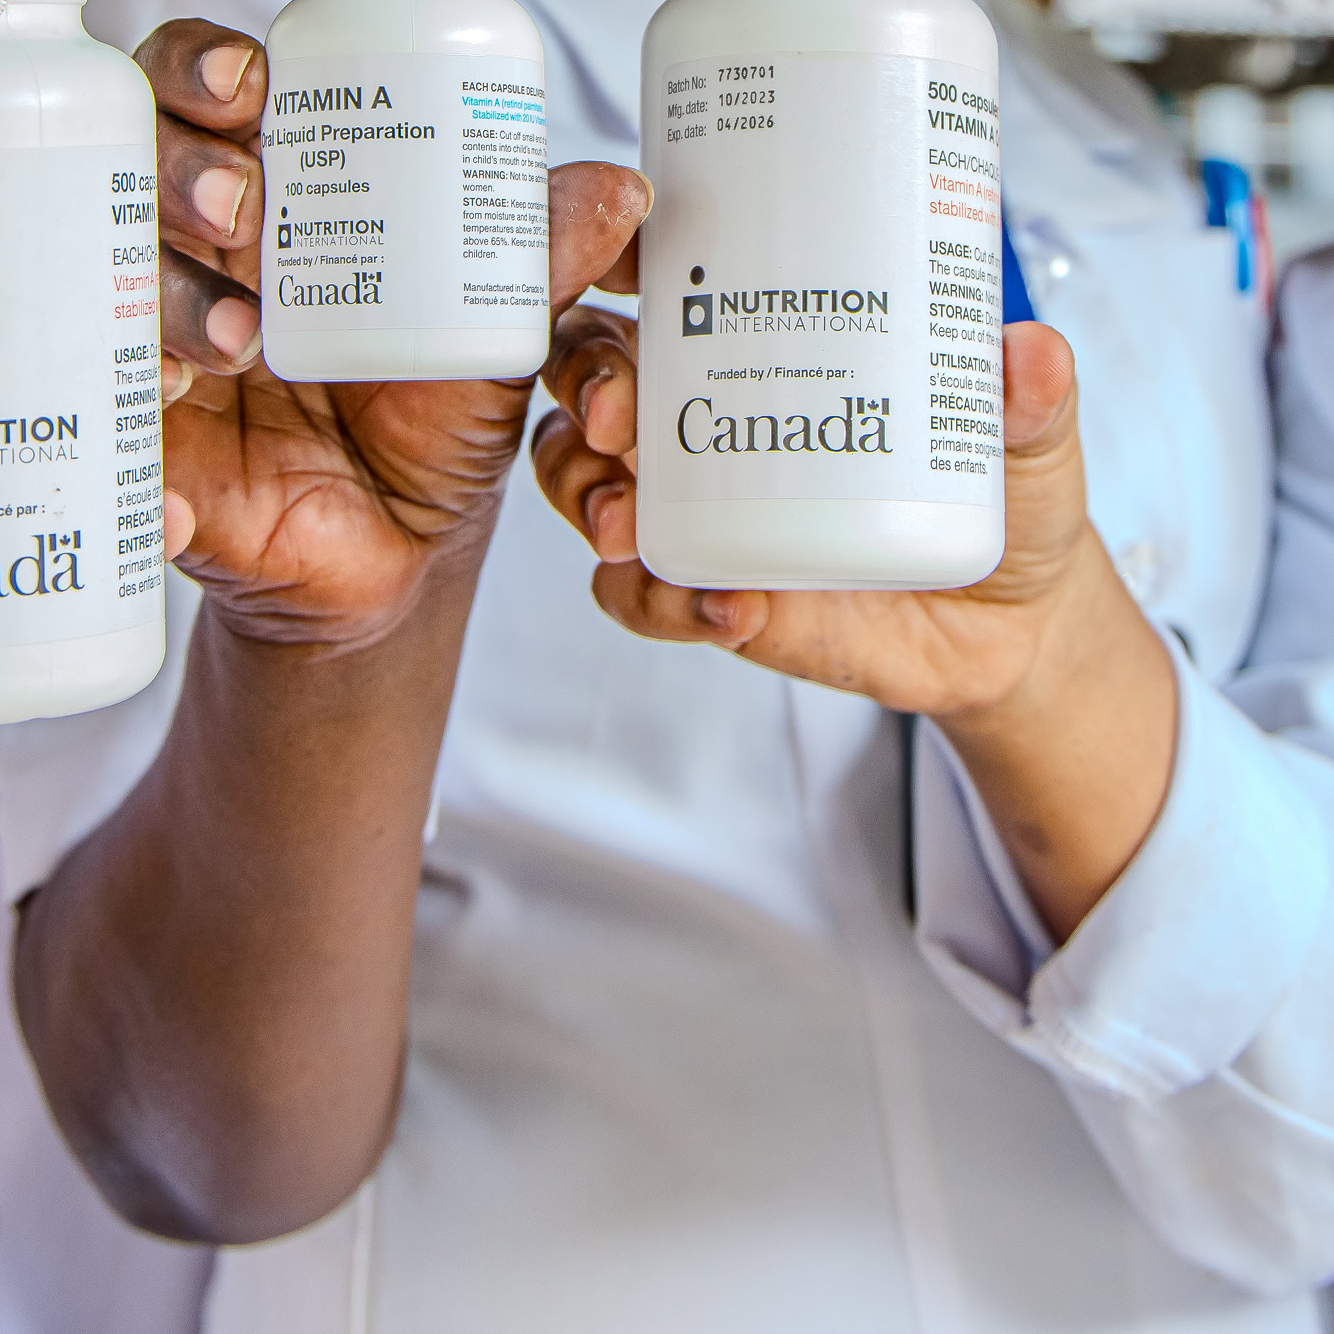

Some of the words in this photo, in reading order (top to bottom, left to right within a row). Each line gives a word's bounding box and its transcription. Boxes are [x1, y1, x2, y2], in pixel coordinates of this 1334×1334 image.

[462, 82, 488, 91] EACH
[491, 83, 524, 95] CAPSULE
[668, 78, 689, 94] Batch
[692, 76, 707, 90] No:
[718, 65, 774, 82] 7730701
[274, 86, 362, 116] VITAMIN
[371, 86, 392, 109] A
[928, 81, 957, 102] 500
[462, 97, 492, 106] Vitamin
[495, 98, 500, 107] A
[668, 104, 684, 118] Mfg.
[686, 100, 707, 114] date:
[719, 90, 775, 106] 10/2023
[472, 110, 509, 120] Stabilized
[262, 130, 274, 148] Oral
[276, 125, 315, 147] Liquid
[321, 122, 435, 144] Preparation
[462, 129, 497, 138] USAGE:
[500, 130, 511, 140] Cut
[668, 128, 683, 143] Exp.
[685, 124, 707, 139] date:
[717, 115, 774, 131] 04/2026
[928, 110, 987, 140] VITAMIN
[990, 126, 995, 144] A
[462, 143, 497, 151] contents
[499, 143, 511, 152] into
[513, 144, 530, 154] child's
[301, 149, 346, 172] (USP)
[462, 155, 470, 163] in
[473, 155, 497, 164] child's
[500, 157, 519, 167] mouth
[521, 159, 527, 167] or
[111, 172, 136, 193] 500
[139, 175, 156, 195] caps
[462, 170, 508, 180] WARNING:
[510, 171, 521, 180] Not
[528, 174, 534, 182] be
[285, 182, 302, 196] 100
[307, 179, 370, 197] capsules
[462, 184, 495, 192] women.
[929, 173, 975, 196] Vitamin
[976, 182, 983, 199] A
[112, 201, 156, 225] VITAMIN
[463, 197, 508, 207] STORAGE:
[511, 199, 526, 210] Keep
[929, 200, 983, 222] stabilized
[463, 210, 482, 219] from
[485, 210, 515, 221] moisture
[517, 213, 527, 221] and
[295, 220, 383, 236] NUTRITION
[463, 224, 514, 234] temperatures
[516, 225, 532, 234] above
[294, 235, 384, 247] INTERNATIONAL
[463, 236, 488, 245] above
[491, 237, 509, 246] 65%.
[511, 237, 527, 248] Keep
[278, 257, 301, 267] Funded
[304, 256, 313, 267] by
[315, 256, 318, 264] /
[321, 254, 357, 264] Financé
[361, 255, 378, 266] par
[463, 249, 497, 258] children.
[929, 240, 972, 259] USAGE:
[974, 247, 987, 263] Cut
[929, 259, 950, 275] The
[954, 265, 985, 281] capsule
[113, 274, 150, 292] Vitamin
[279, 272, 383, 307] Canada
[463, 283, 513, 292] Manufactured
[515, 284, 520, 292] in
[522, 284, 539, 293] Canada
[929, 281, 983, 303] WARNING:
[115, 297, 156, 319] stabilized
[464, 296, 498, 306] Fabriqué
[510, 296, 531, 306] Canada
[720, 290, 888, 315] NUTRITION
[930, 303, 984, 323] STORAGE:
[986, 311, 993, 326] Do
[720, 316, 889, 333] INTERNATIONAL
[930, 322, 958, 341] Keep
[961, 328, 975, 341] out
[978, 330, 984, 343] of
[115, 345, 149, 364] USAGE:
[930, 352, 991, 374] UTILISATION
[115, 370, 133, 385] The
[135, 365, 157, 384] capsule
[708, 368, 747, 380] Funded
[751, 368, 764, 381] by
[767, 367, 771, 378] /
[775, 367, 823, 379] Financé
[827, 370, 847, 380] par
[930, 373, 973, 390] s'écoule
[975, 378, 991, 393] dans
[931, 392, 994, 415] PRÉCAUTION
[677, 397, 893, 454] Canada
[931, 416, 998, 438] ENTREPOSAGE
[117, 438, 140, 454] Keep
[931, 437, 972, 453] primaire
[930, 456, 951, 470] des
[955, 458, 987, 475] enfants.
[17, 502, 38, 518] par
[119, 556, 152, 580] primaire
[119, 582, 136, 598] des
